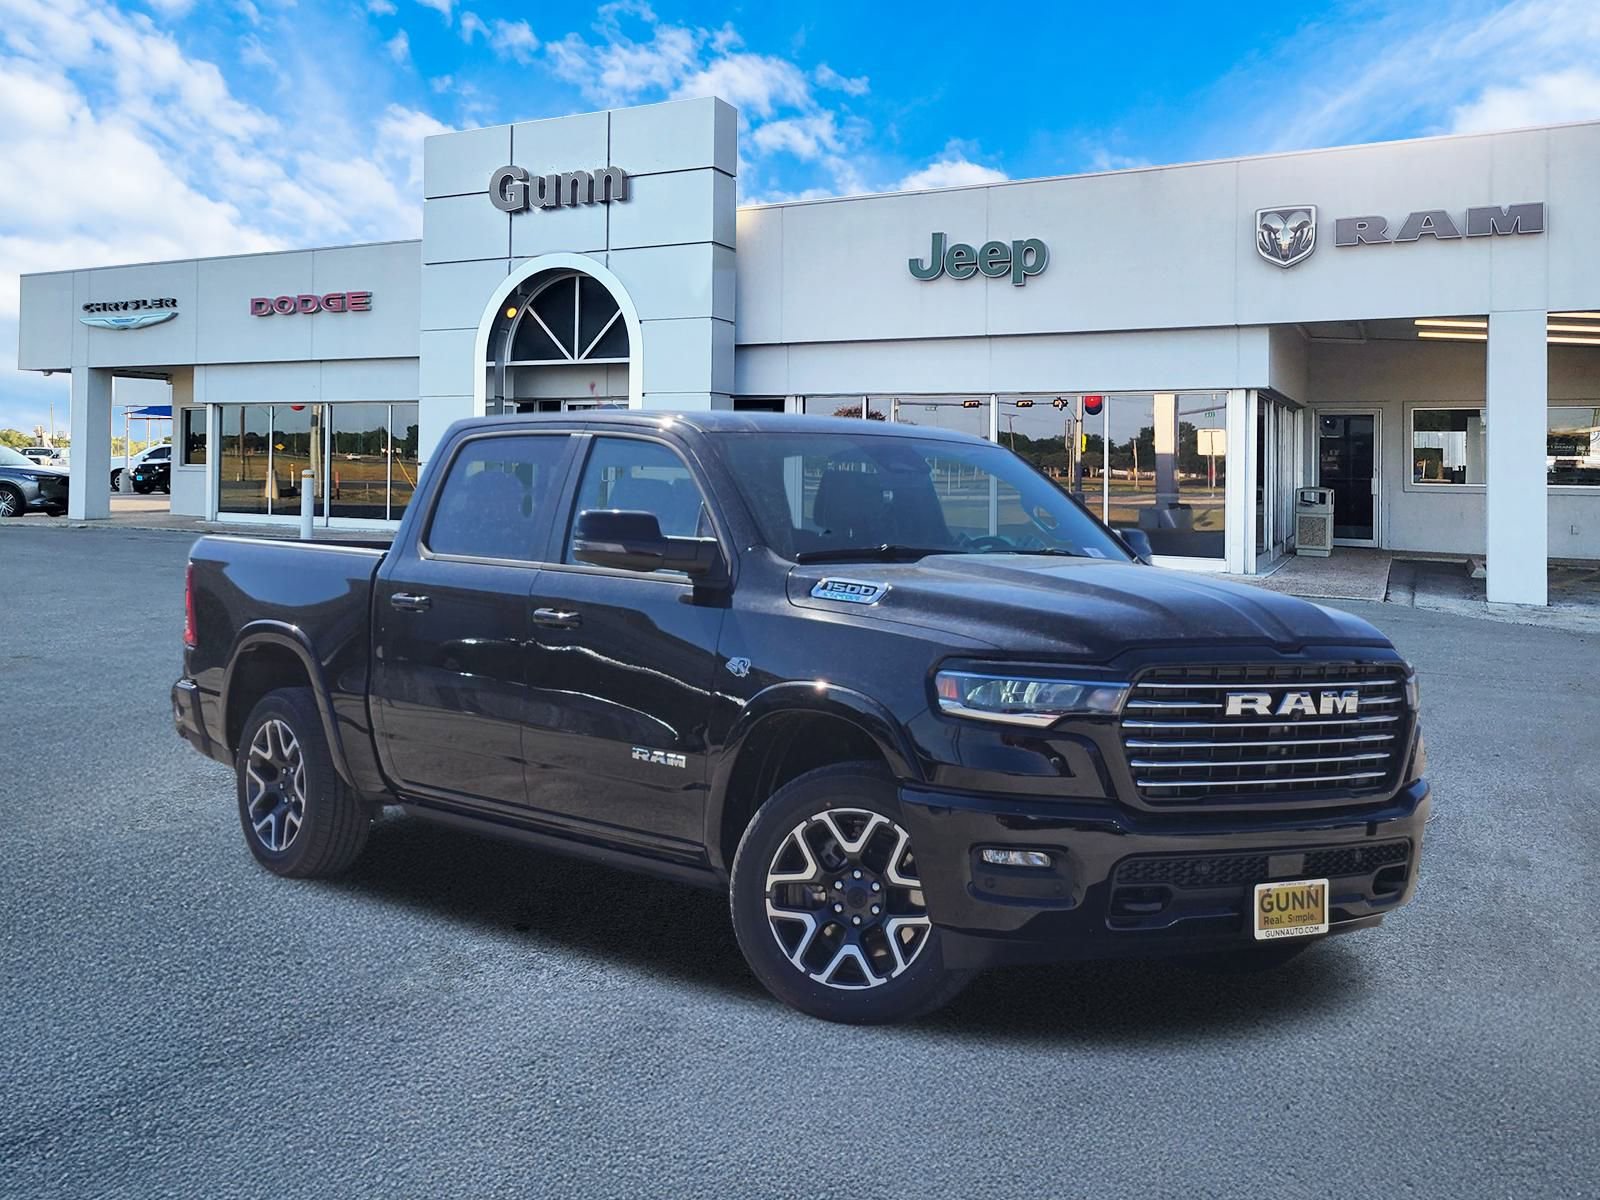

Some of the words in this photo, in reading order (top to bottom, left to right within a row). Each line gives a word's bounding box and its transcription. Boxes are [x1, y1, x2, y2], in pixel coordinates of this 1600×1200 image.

[489, 165, 627, 212] Gunn
[1335, 202, 1545, 247] RAM
[908, 232, 1049, 286] Jeep
[82, 298, 177, 313] CHRYSLER
[250, 291, 373, 317] DODGE
[826, 582, 876, 595] 1500
[1225, 690, 1359, 716] RAM
[631, 746, 686, 768] RAM
[1260, 890, 1319, 913] GUNN
[1265, 926, 1320, 937] GUNNAUTO.COM
